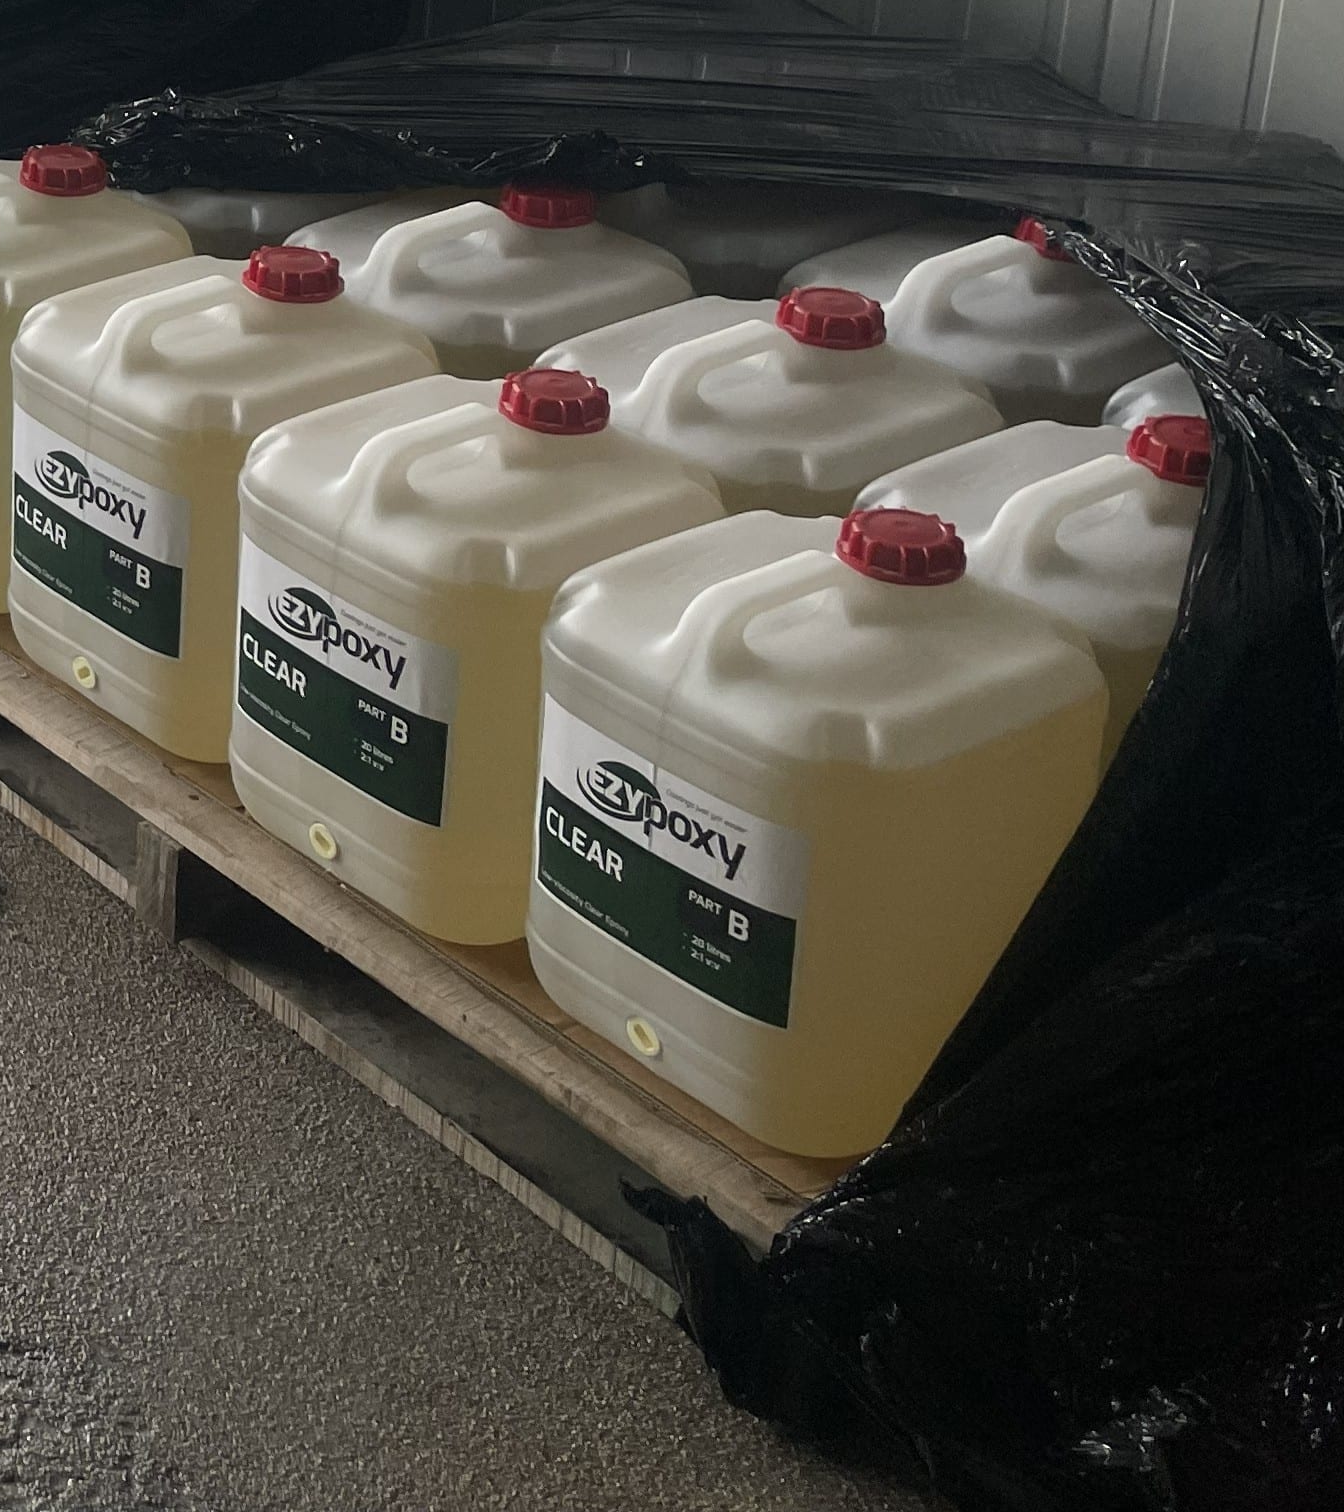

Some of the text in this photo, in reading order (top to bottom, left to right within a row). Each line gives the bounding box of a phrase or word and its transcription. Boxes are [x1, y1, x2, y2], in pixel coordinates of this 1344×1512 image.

[16, 494, 68, 550] CLEAR
[42, 457, 146, 539] EZYpoxy
[109, 549, 151, 589] PART B
[243, 633, 308, 698] CLEAR
[277, 593, 406, 690] EZYpoxy
[358, 699, 409, 745] PART B
[545, 806, 623, 882] CLEAR
[589, 766, 746, 881] EZYpoxy
[688, 888, 749, 942] PART B
